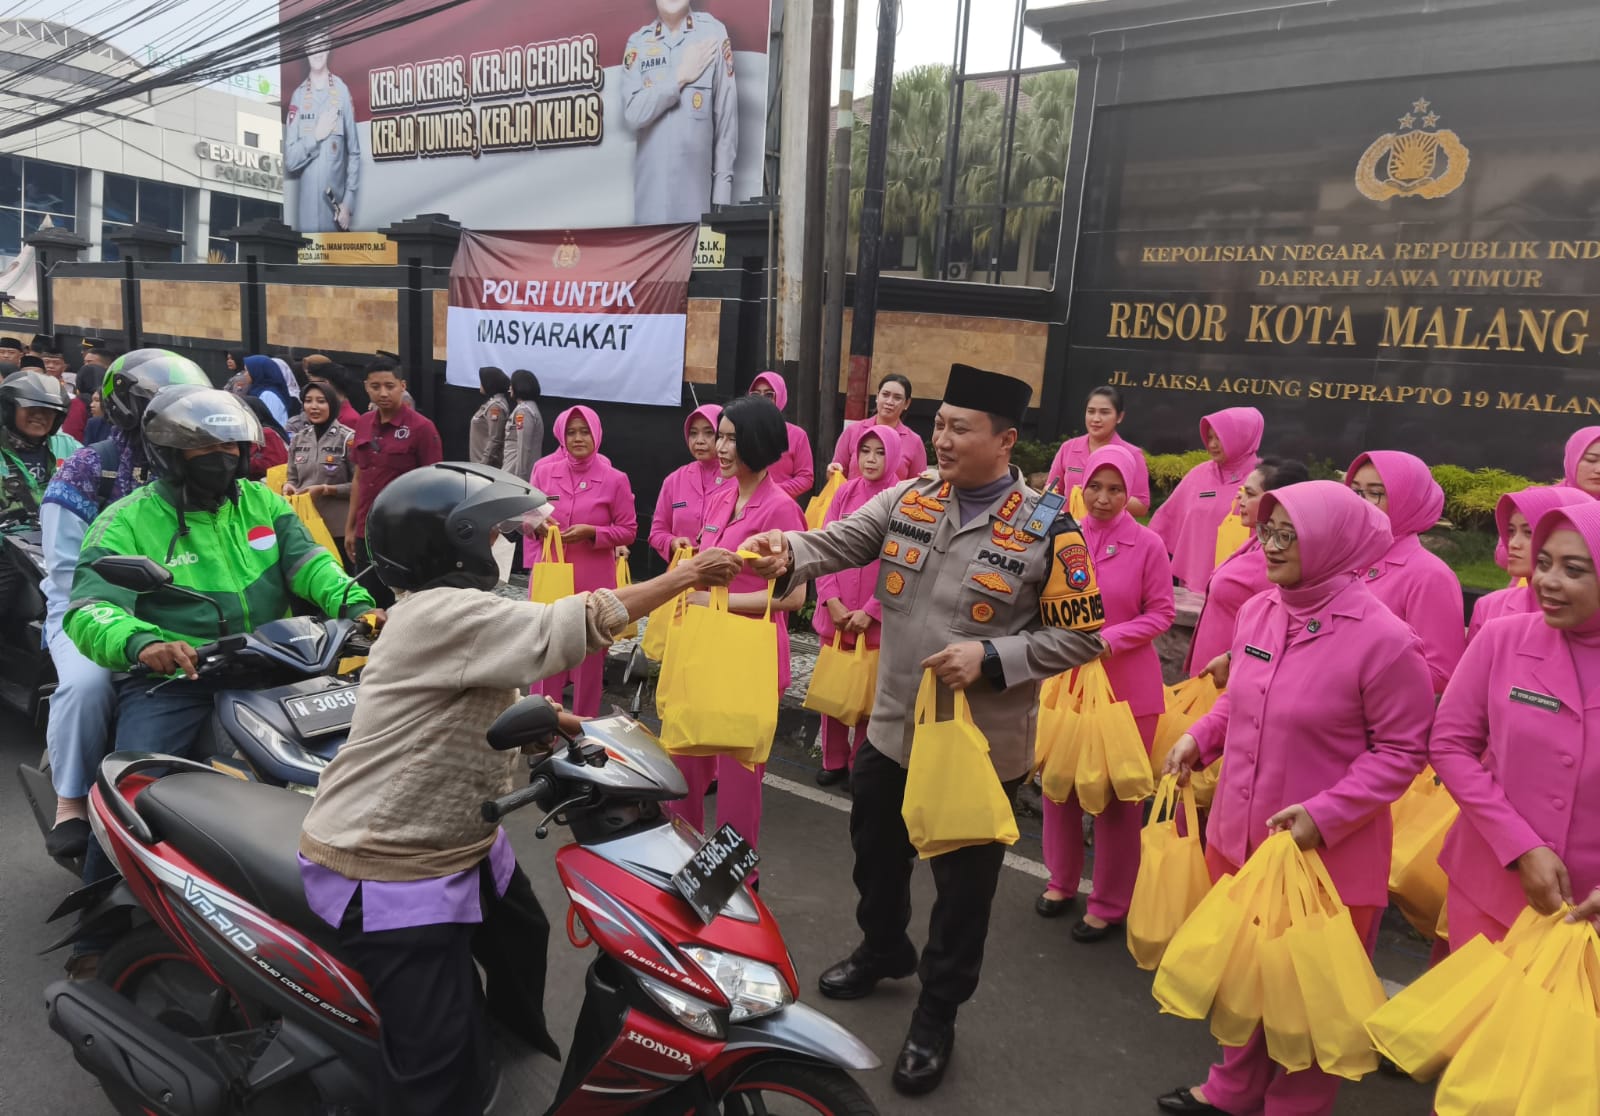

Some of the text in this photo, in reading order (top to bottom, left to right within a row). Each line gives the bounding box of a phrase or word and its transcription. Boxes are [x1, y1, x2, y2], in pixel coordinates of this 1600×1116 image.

[370, 37, 600, 108] KERJA KERAS, KERJA CERDAS,
[371, 96, 600, 156] KERJA TUNTAS, KERJA IKHLAS
[195, 141, 272, 172] GEDUNG
[1141, 245, 1276, 264] KEPOLISIAN
[1281, 243, 1386, 261] NEGARA
[1394, 240, 1541, 261] REPUBLIK
[481, 279, 636, 307] POLRI UNTUK
[1257, 269, 1544, 288] DAERAH JAWA TIMUR
[477, 319, 633, 350] MASYARAKAT
[1106, 301, 1589, 356] RESOR KOTA MALANG
[1107, 370, 1137, 386] JL.
[1142, 372, 1211, 392] JAKSA
[1216, 376, 1302, 397] AGUNG
[1308, 381, 1453, 406] SUPRAPTO
[1460, 390, 1490, 408] 19
[978, 549, 1025, 575] POLRI
[294, 690, 357, 717] N 3058
[679, 867, 701, 900] AG
[183, 874, 257, 952] VARIO
[627, 1030, 693, 1066] HONDA
